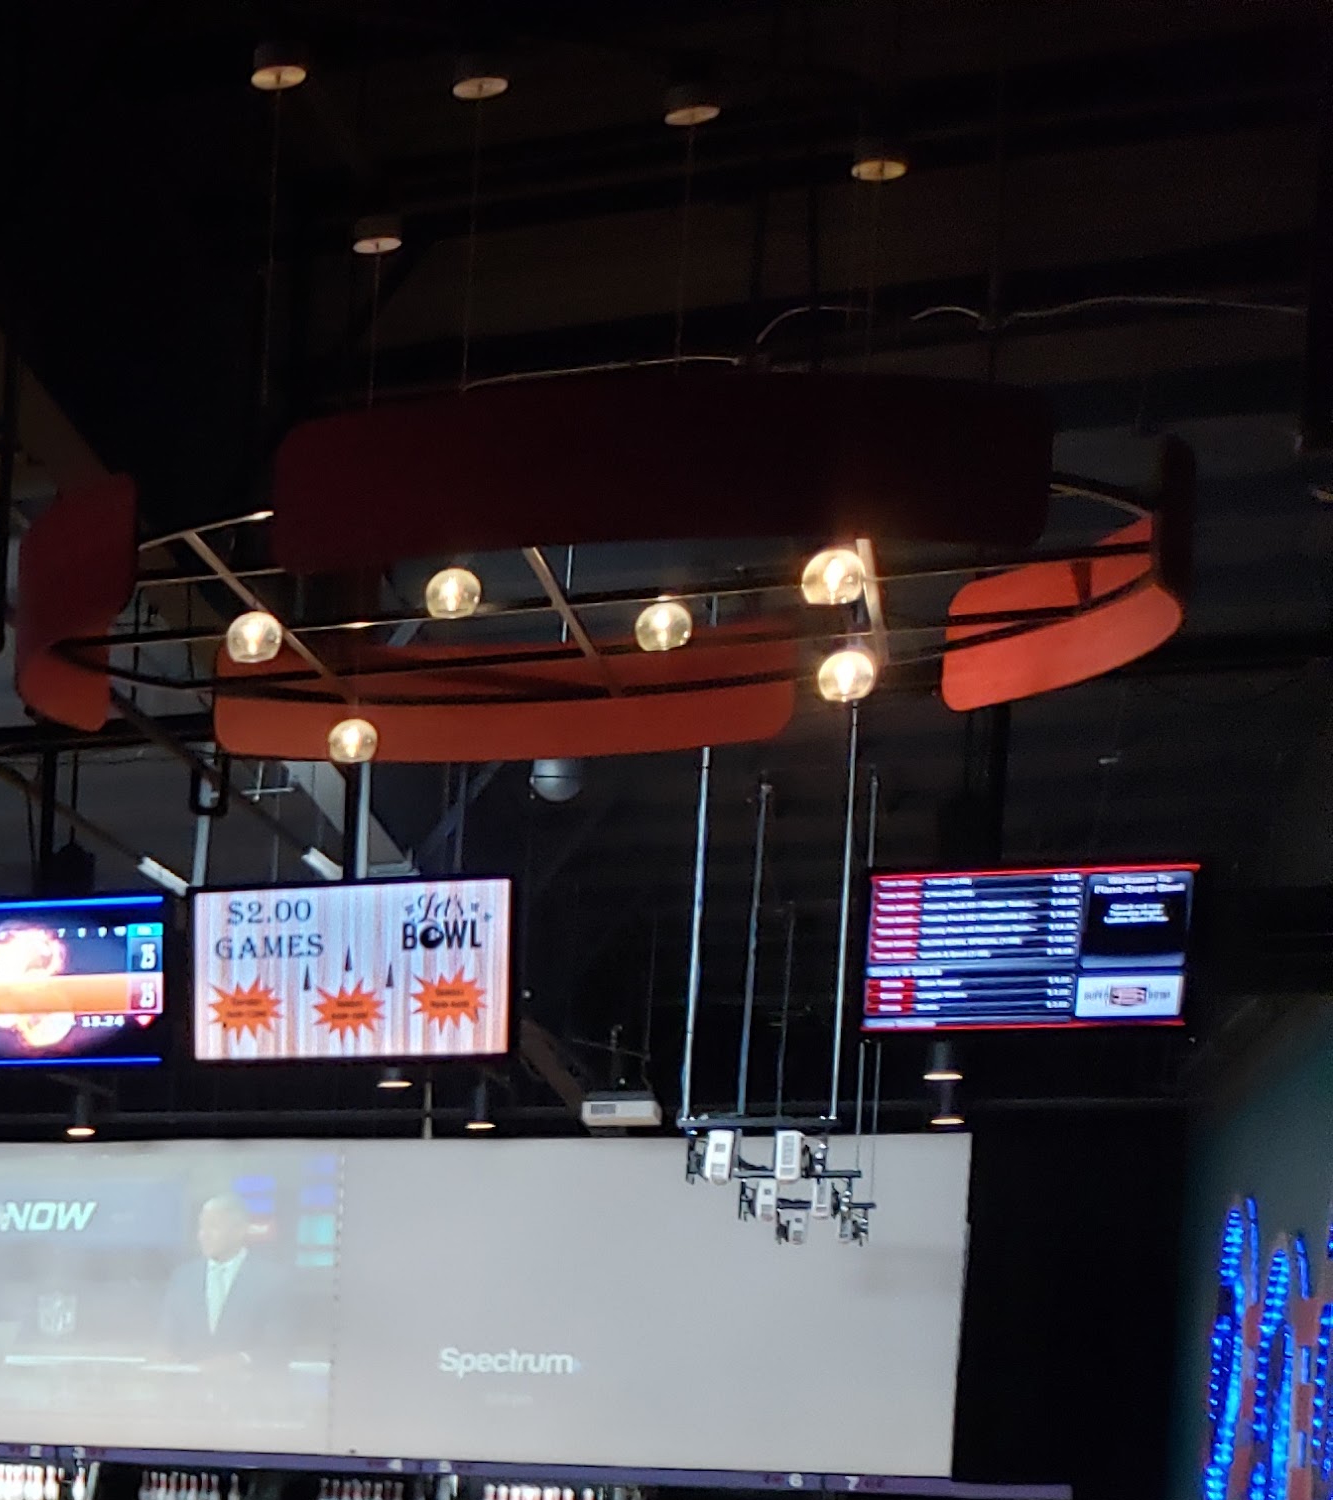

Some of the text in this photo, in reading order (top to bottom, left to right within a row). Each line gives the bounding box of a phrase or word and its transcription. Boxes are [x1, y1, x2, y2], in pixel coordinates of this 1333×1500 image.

[227, 899, 311, 925] $2.00
[216, 934, 324, 960] GAMES
[402, 920, 481, 950] BOWL
[0, 1201, 97, 1232] NOW
[439, 1347, 574, 1380] Spectrum
[845, 1476, 860, 1491] 7
